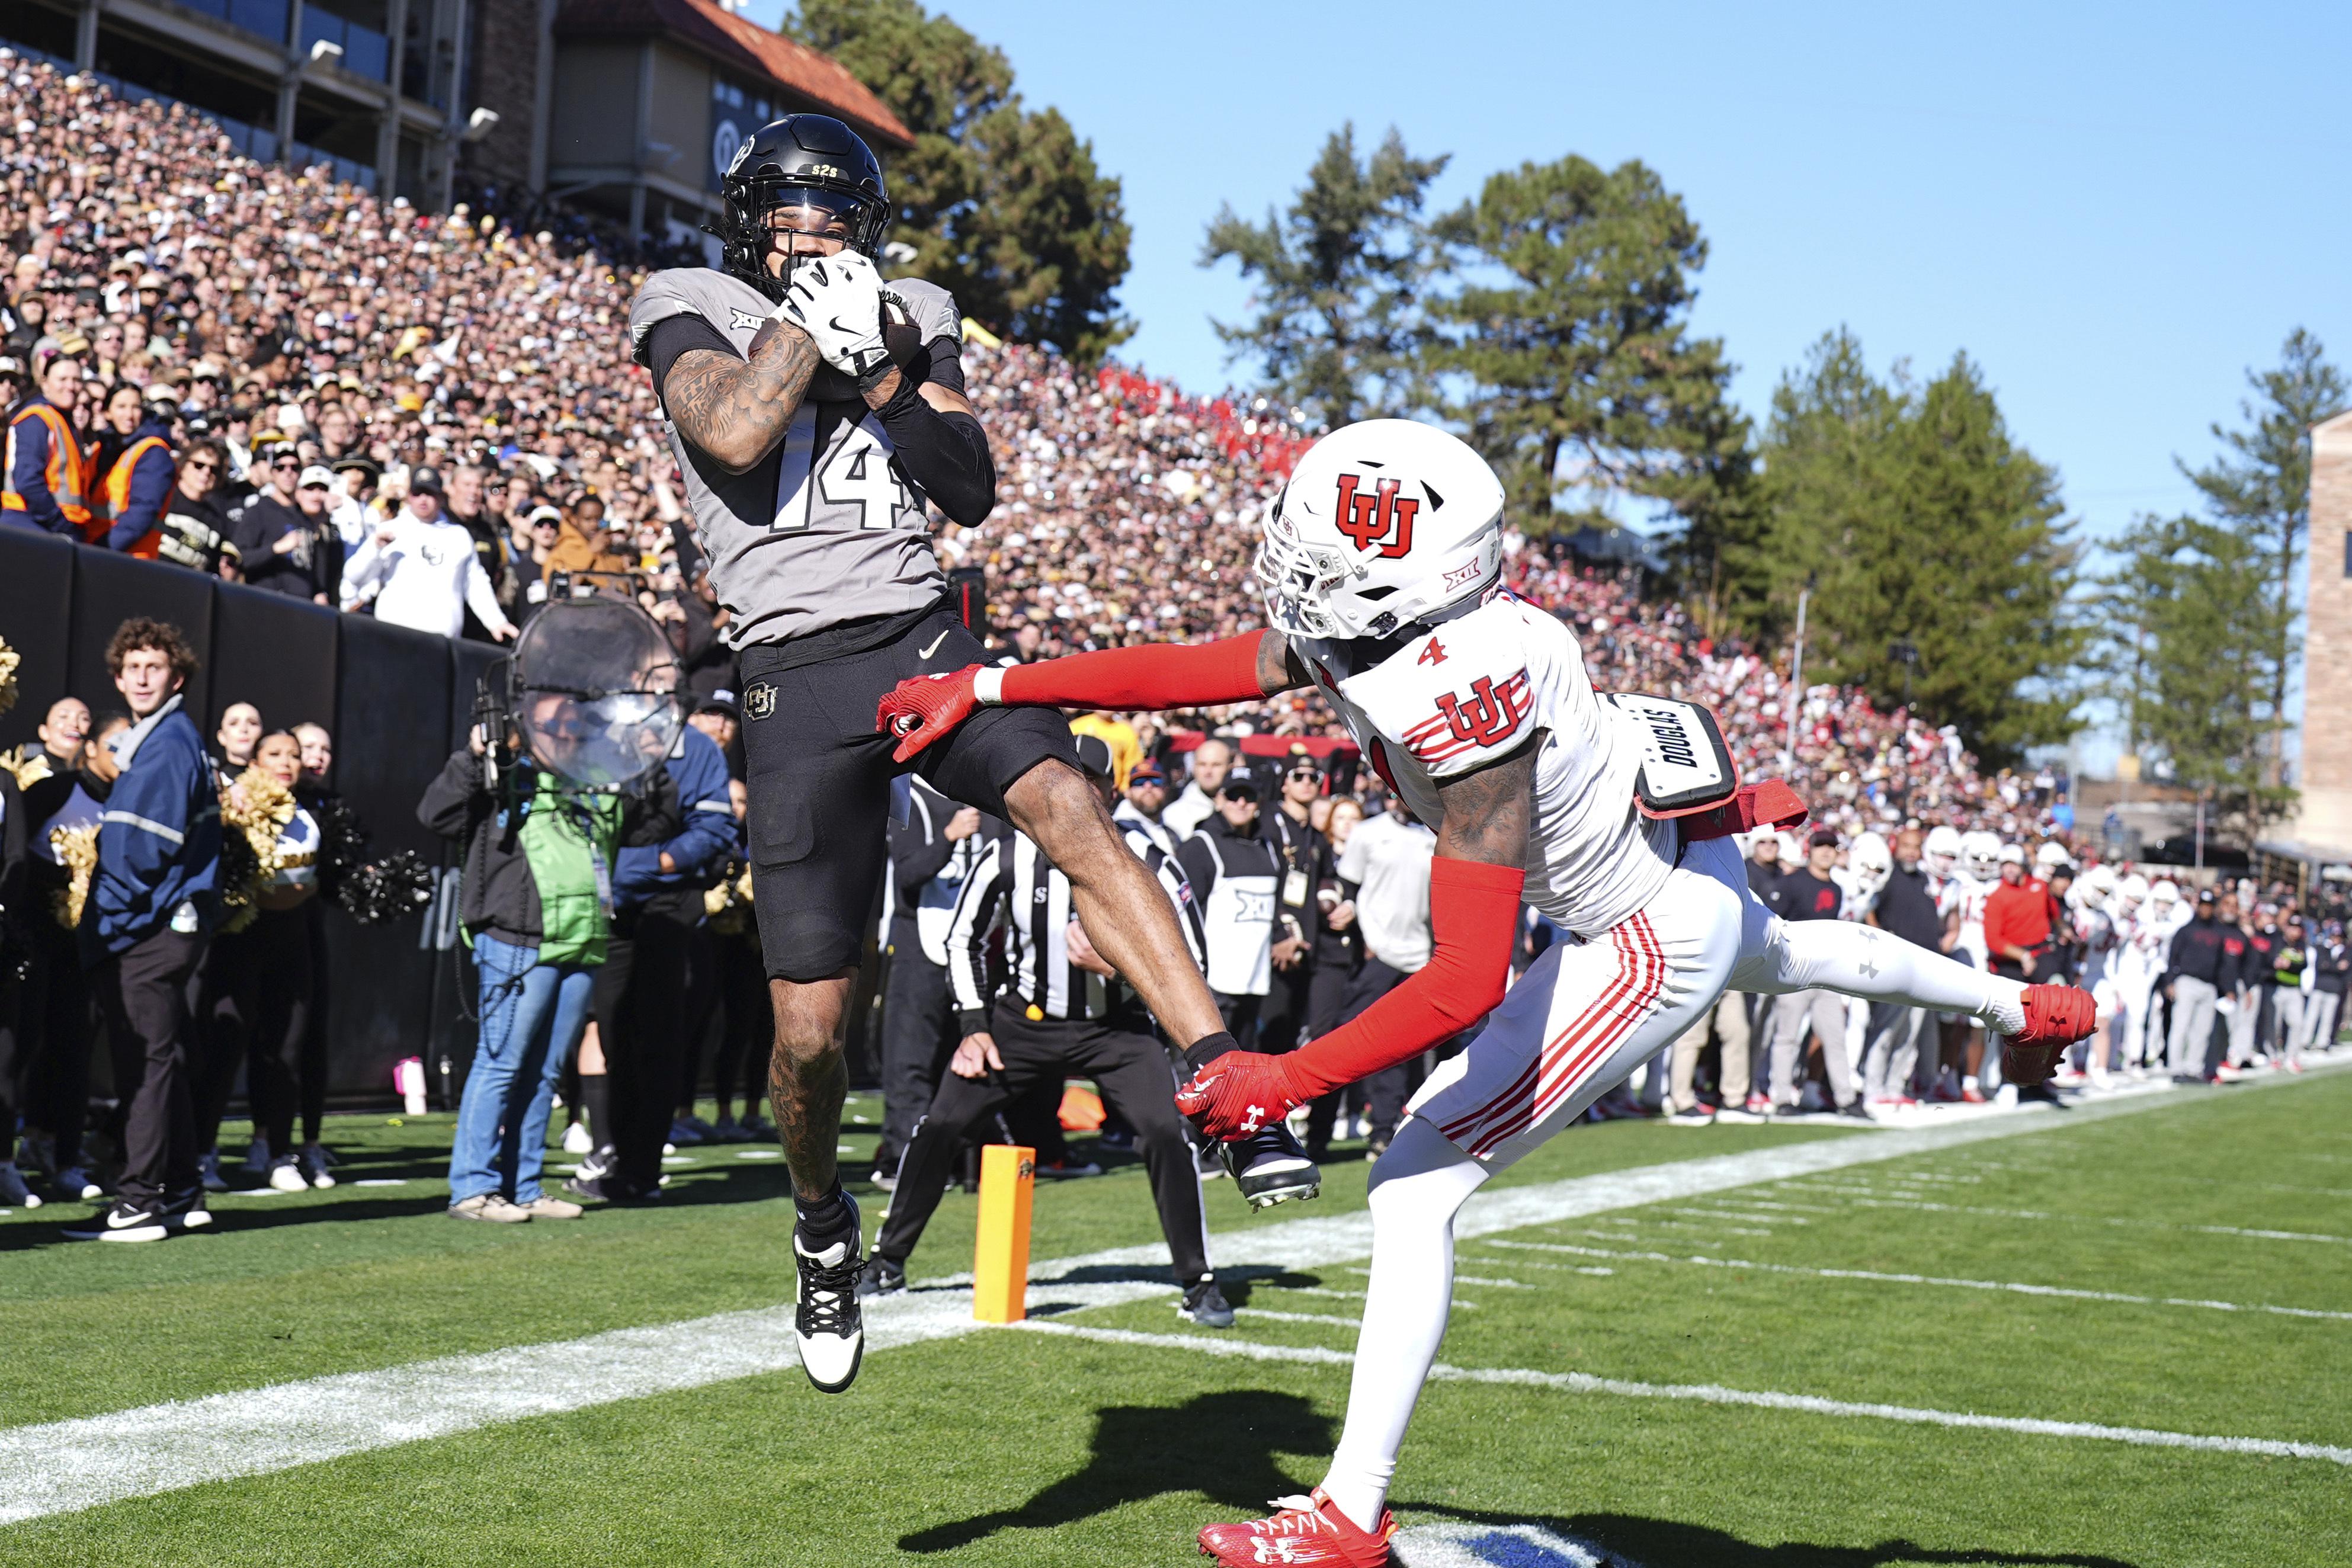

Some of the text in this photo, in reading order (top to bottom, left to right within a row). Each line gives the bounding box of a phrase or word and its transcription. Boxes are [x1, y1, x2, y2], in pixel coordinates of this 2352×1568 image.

[1417, 636, 1449, 666] 4
[1642, 708, 1698, 768] DOUGLAS
[1034, 886, 1047, 904] S
